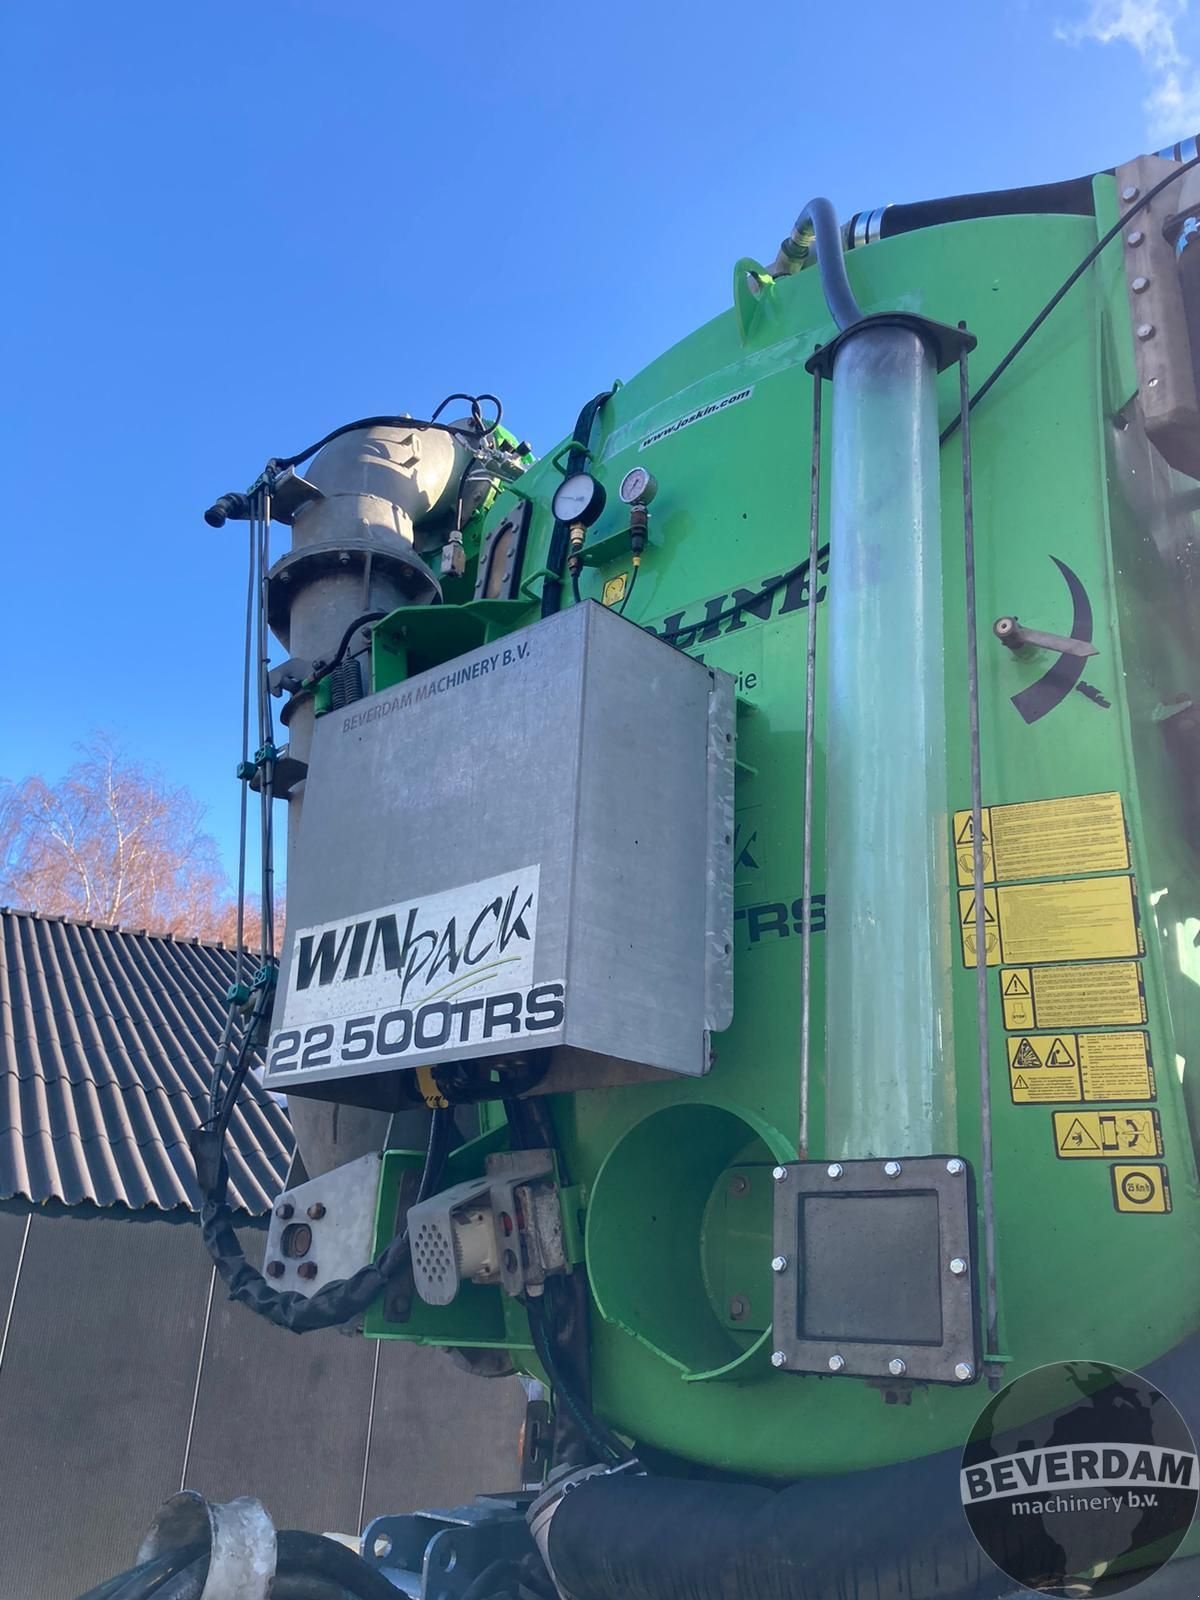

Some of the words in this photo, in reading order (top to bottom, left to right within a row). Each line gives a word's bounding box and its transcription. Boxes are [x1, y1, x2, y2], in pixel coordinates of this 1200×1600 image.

[643, 390, 751, 446] www.joskin.com
[643, 560, 830, 649] LINE
[342, 691, 412, 734] BEVERDAM
[415, 654, 500, 700] MACHINERY
[502, 642, 530, 666] B.V.
